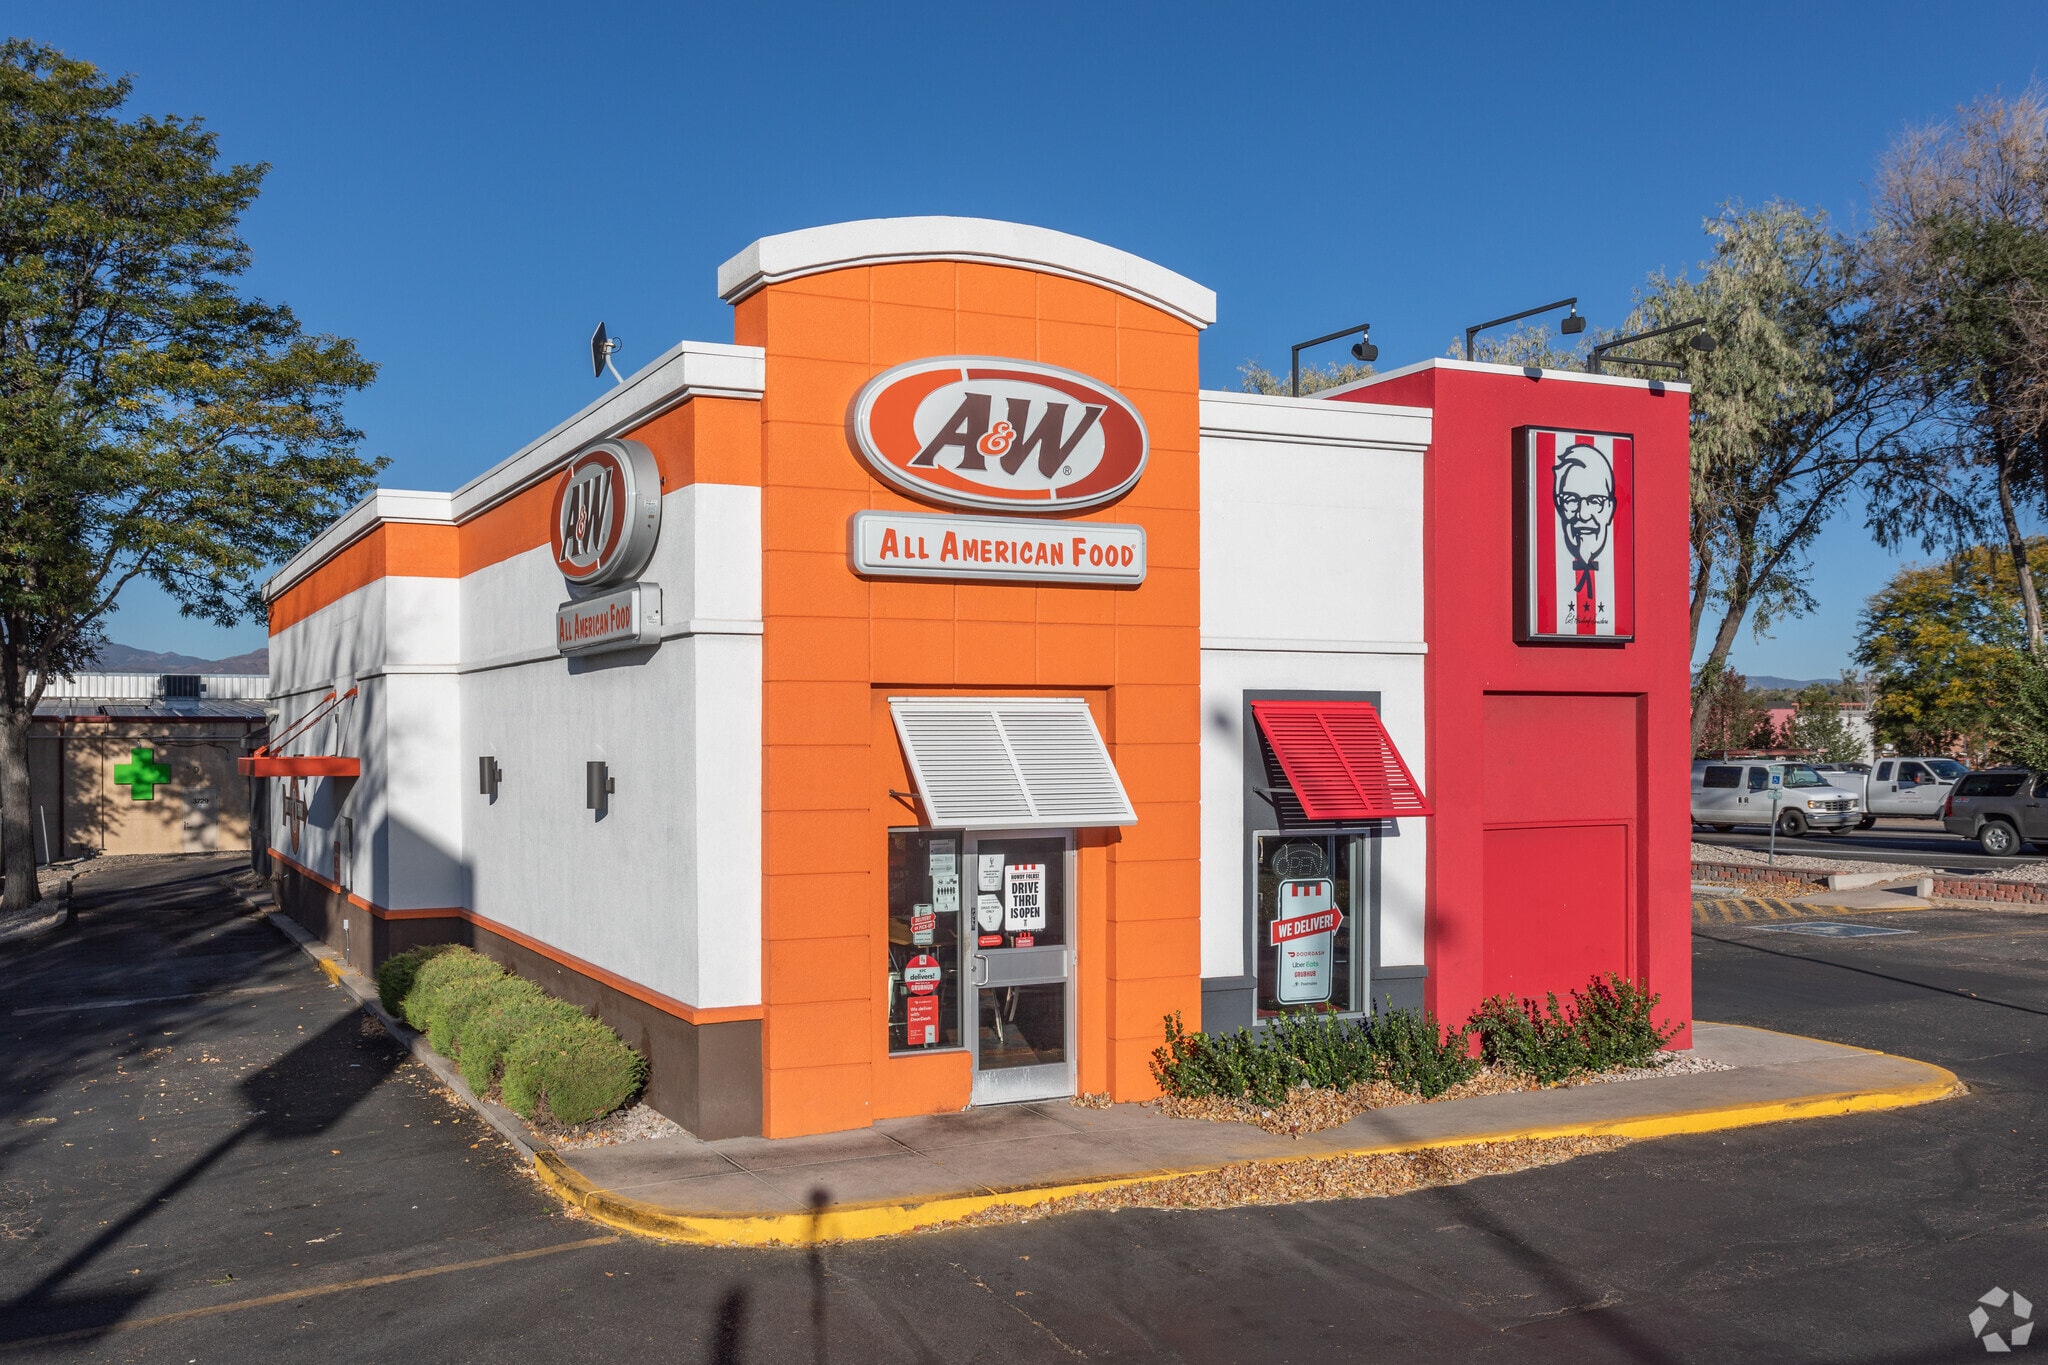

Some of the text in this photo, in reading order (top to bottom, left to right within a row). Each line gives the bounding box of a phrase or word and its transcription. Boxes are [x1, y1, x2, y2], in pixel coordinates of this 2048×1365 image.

[911, 392, 1104, 479] A&W
[559, 469, 614, 562] A&W
[879, 527, 1135, 567] ALL AMERICAN FOOD
[559, 603, 631, 644] ALL AMERICAN FOOD
[1276, 856, 1323, 876] OPEN
[1012, 882, 1039, 894] DRIVE
[1013, 894, 1038, 907] THRU
[1010, 906, 1040, 919] IS OPEN
[1278, 913, 1334, 938] WE DELIVER!
